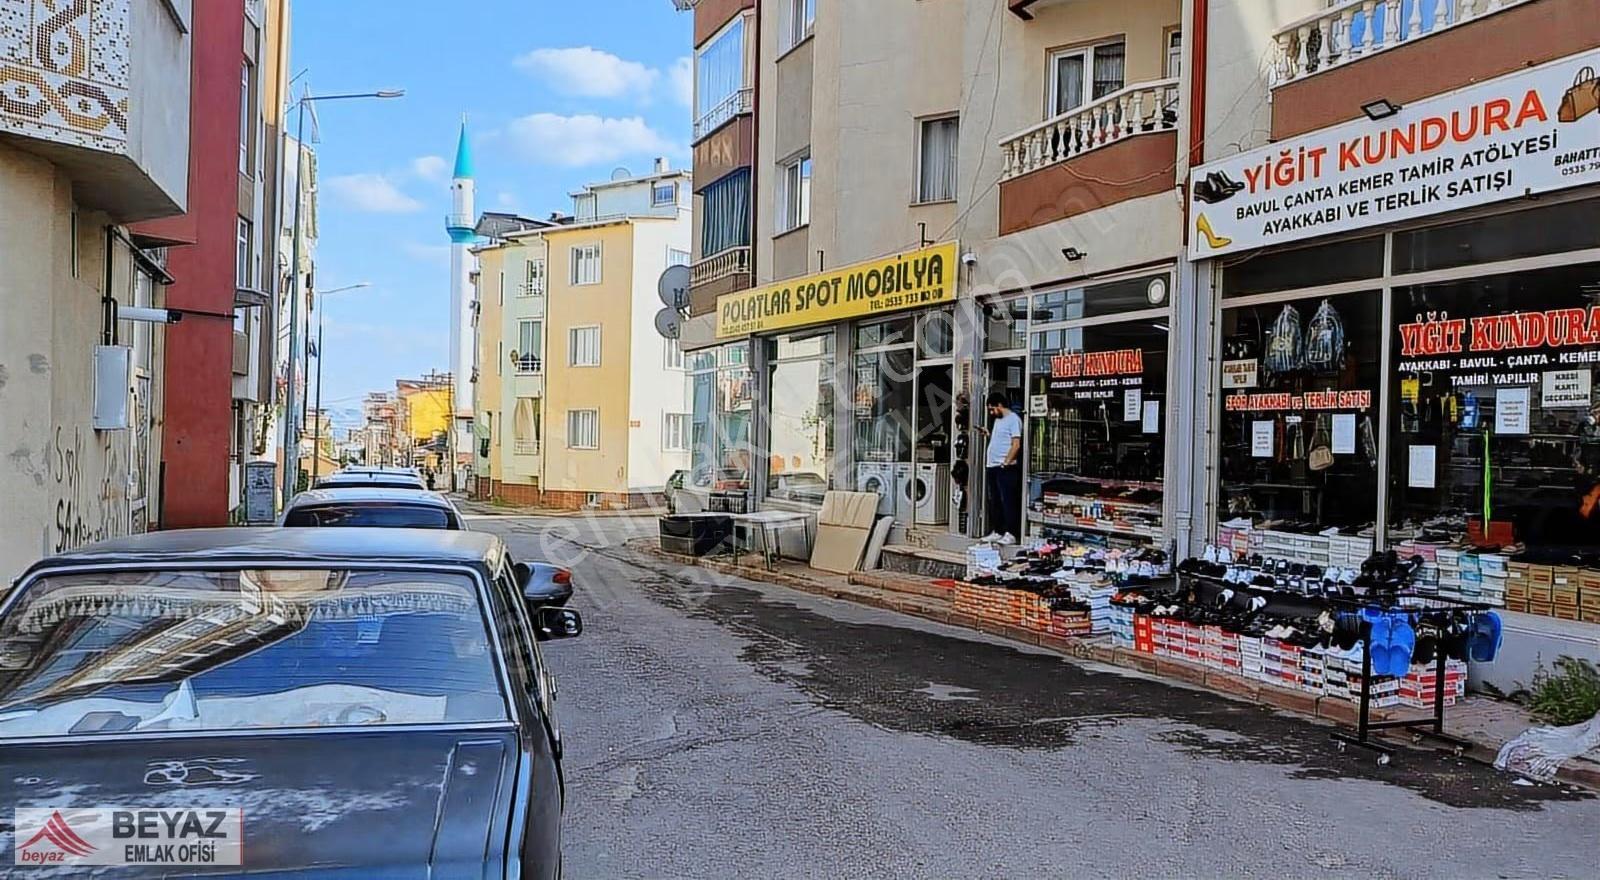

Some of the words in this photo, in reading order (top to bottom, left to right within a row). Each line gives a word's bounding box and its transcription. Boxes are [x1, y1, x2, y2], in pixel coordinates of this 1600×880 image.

[1243, 146, 1328, 194] YİĞİT
[1338, 89, 1549, 172] KUNDURA
[1554, 146, 1600, 172] BAHATT
[1236, 198, 1280, 220] BAVUL
[1284, 186, 1334, 211] ÇANTA
[1338, 173, 1395, 196] KEMER
[1399, 156, 1455, 183] TAMİR
[1460, 129, 1559, 170] ATÖLYESİ
[1262, 207, 1342, 236] AYAKKABI
[1345, 201, 1370, 218] VE
[1374, 184, 1441, 214] TERLİK
[1446, 169, 1514, 199] SATIŞI
[722, 290, 791, 326] POLATLAR
[795, 277, 843, 311] SPOT
[846, 254, 944, 303] MOBİLYA
[1399, 311, 1466, 356] YİĞİT
[1083, 348, 1143, 376] KUNDURA
[1398, 360, 1451, 371] AYAKKABI
[1460, 357, 1497, 369] BAVUL
[1507, 354, 1549, 368] ÇANTA
[1450, 372, 1489, 386] TAMİRİ
[1492, 372, 1539, 385] YAPILIR
[1226, 395, 1249, 410] SPOR
[1304, 387, 1338, 410] TERLİK
[1339, 389, 1371, 412] SATIŞI
